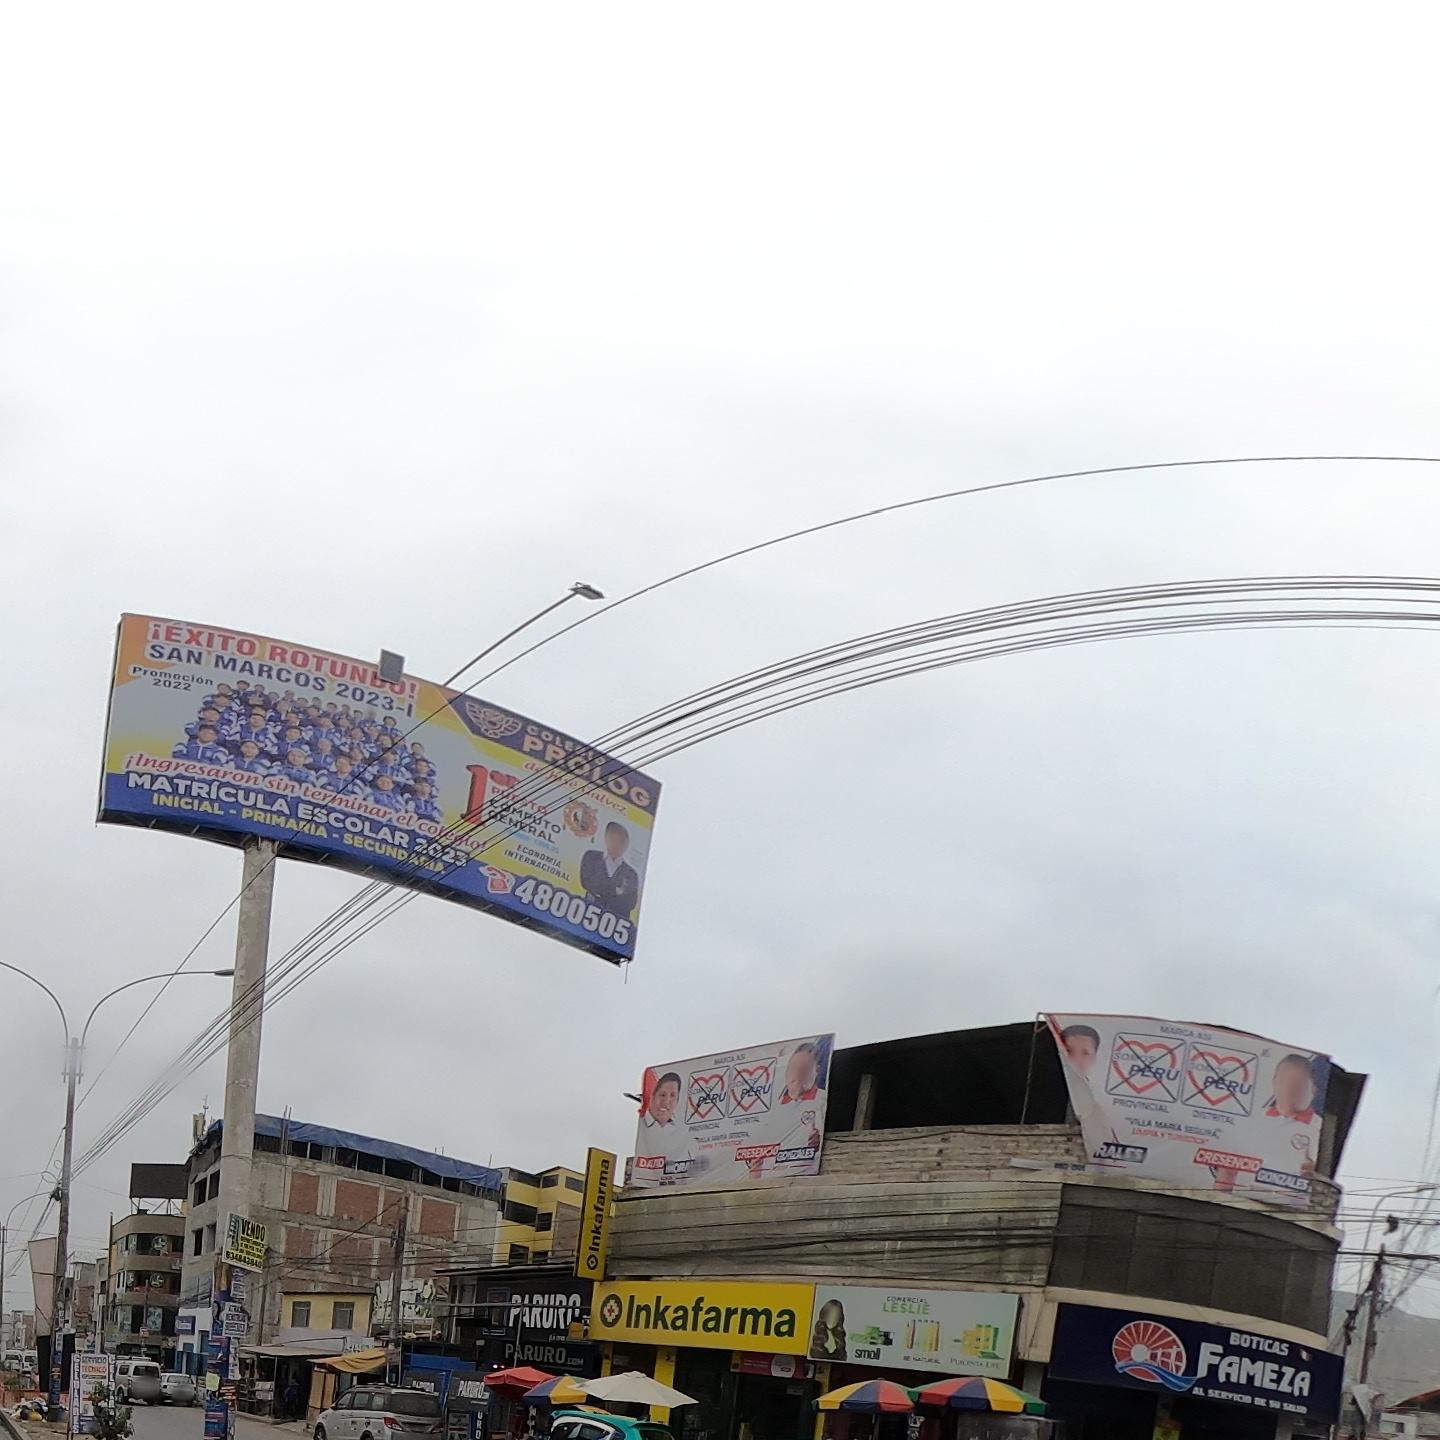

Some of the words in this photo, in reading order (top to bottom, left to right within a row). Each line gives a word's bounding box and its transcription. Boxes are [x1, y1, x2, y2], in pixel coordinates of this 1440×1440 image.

[151, 622, 256, 656] ¡ÉXITO
[132, 665, 214, 686] Promoción
[149, 643, 202, 666] SAN
[214, 653, 328, 692] MARCOS
[152, 677, 193, 692] 2022
[526, 724, 607, 766] COLEGIO
[522, 734, 651, 808] PROLOG
[266, 774, 297, 793] sin
[302, 783, 390, 820] terminar
[396, 811, 415, 828] el
[128, 772, 292, 816] MATRÍCULA
[297, 804, 410, 848] ESCOLAR
[415, 836, 469, 867] 2023
[152, 792, 224, 816] INICIAL
[241, 808, 329, 839] PRIMARIA
[343, 833, 446, 874] SECUNDARIA
[503, 848, 571, 882] INTERNACIONAL
[514, 878, 632, 946] 4800505
[1159, 1025, 1194, 1038] MARCA
[1129, 1063, 1181, 1082] PERU
[1203, 1075, 1253, 1095] PERU
[1112, 1098, 1170, 1114] PROVINCIAL
[1192, 1109, 1236, 1125] DISTRITAL
[1195, 1149, 1262, 1173] CRESENCIO
[1256, 1170, 1309, 1190] GONZALES
[588, 1157, 611, 1253] Inkafarma
[241, 1218, 266, 1242] VENDO
[508, 1293, 582, 1331] PARURO
[882, 1302, 931, 1316] LESLIE
[886, 1295, 929, 1305] COMERCIAL
[625, 1295, 797, 1339] Inkafarma
[1229, 1331, 1291, 1357] BOTICAS
[1199, 1341, 1312, 1398] FAMEZA
[458, 1380, 486, 1399] PARURO
[1191, 1386, 1205, 1397] AL
[1207, 1388, 1253, 1405] SERVICIO
[1254, 1396, 1268, 1407] DE
[1268, 1398, 1282, 1409] SU
[1282, 1401, 1308, 1415] SALUD
